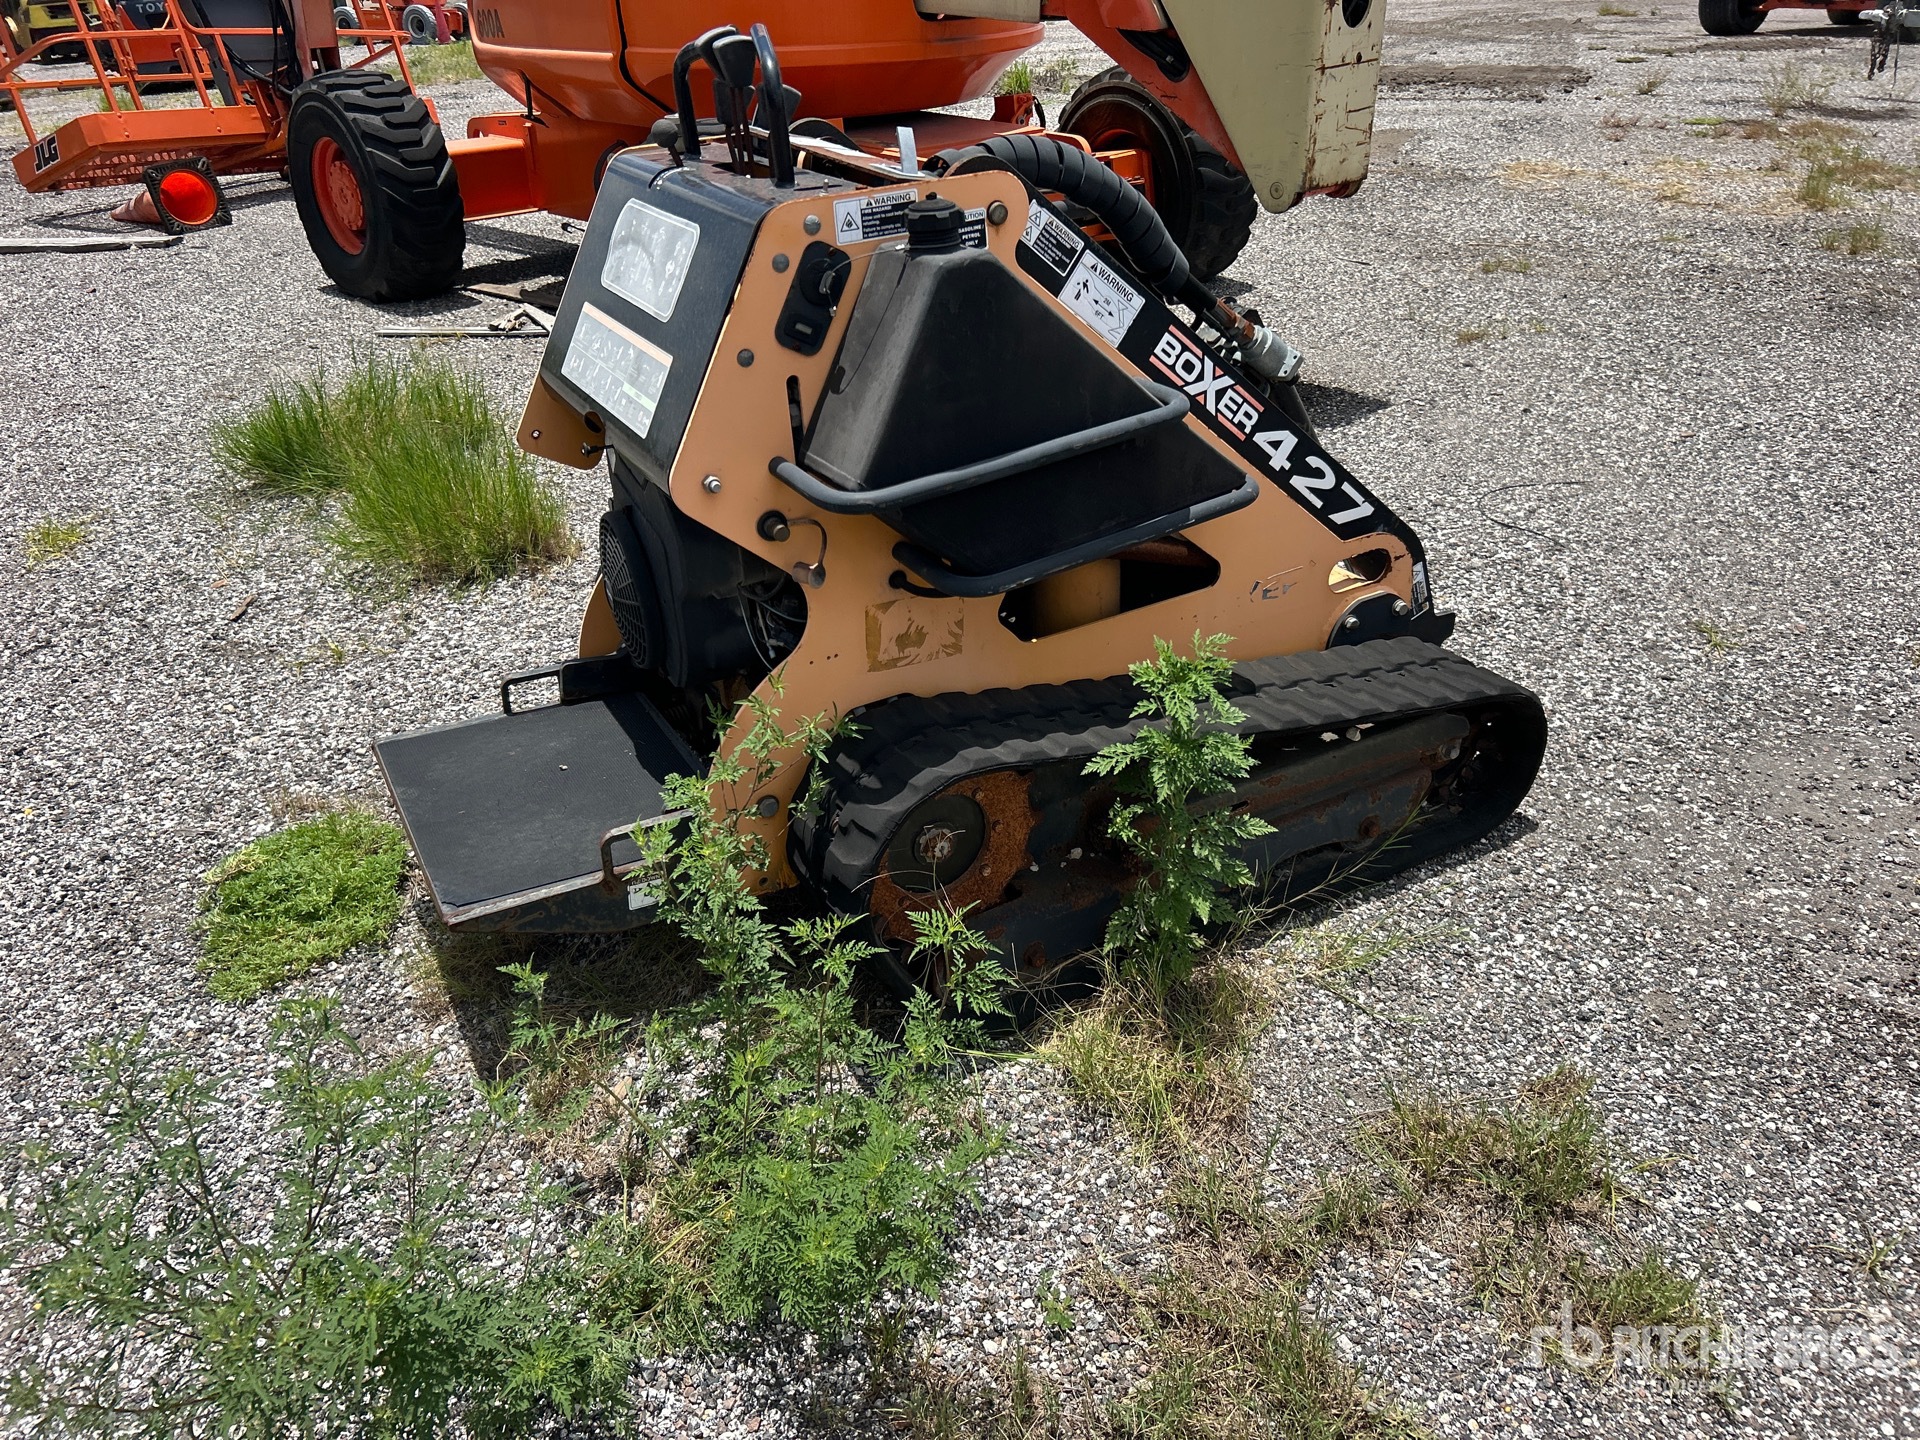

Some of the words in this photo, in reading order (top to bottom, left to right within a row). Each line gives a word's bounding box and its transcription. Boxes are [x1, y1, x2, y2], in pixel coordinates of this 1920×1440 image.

[136, 2, 164, 13] TOY
[477, 9, 505, 38] 600A
[34, 134, 60, 174] JLG
[873, 193, 911, 205] WARNING
[965, 211, 984, 220] UTION
[1054, 223, 1080, 249] WARNING
[1098, 267, 1134, 303] WARNING
[1103, 298, 1111, 306] 2M
[1153, 332, 1259, 434] BOXER
[1252, 430, 1375, 524] 427
